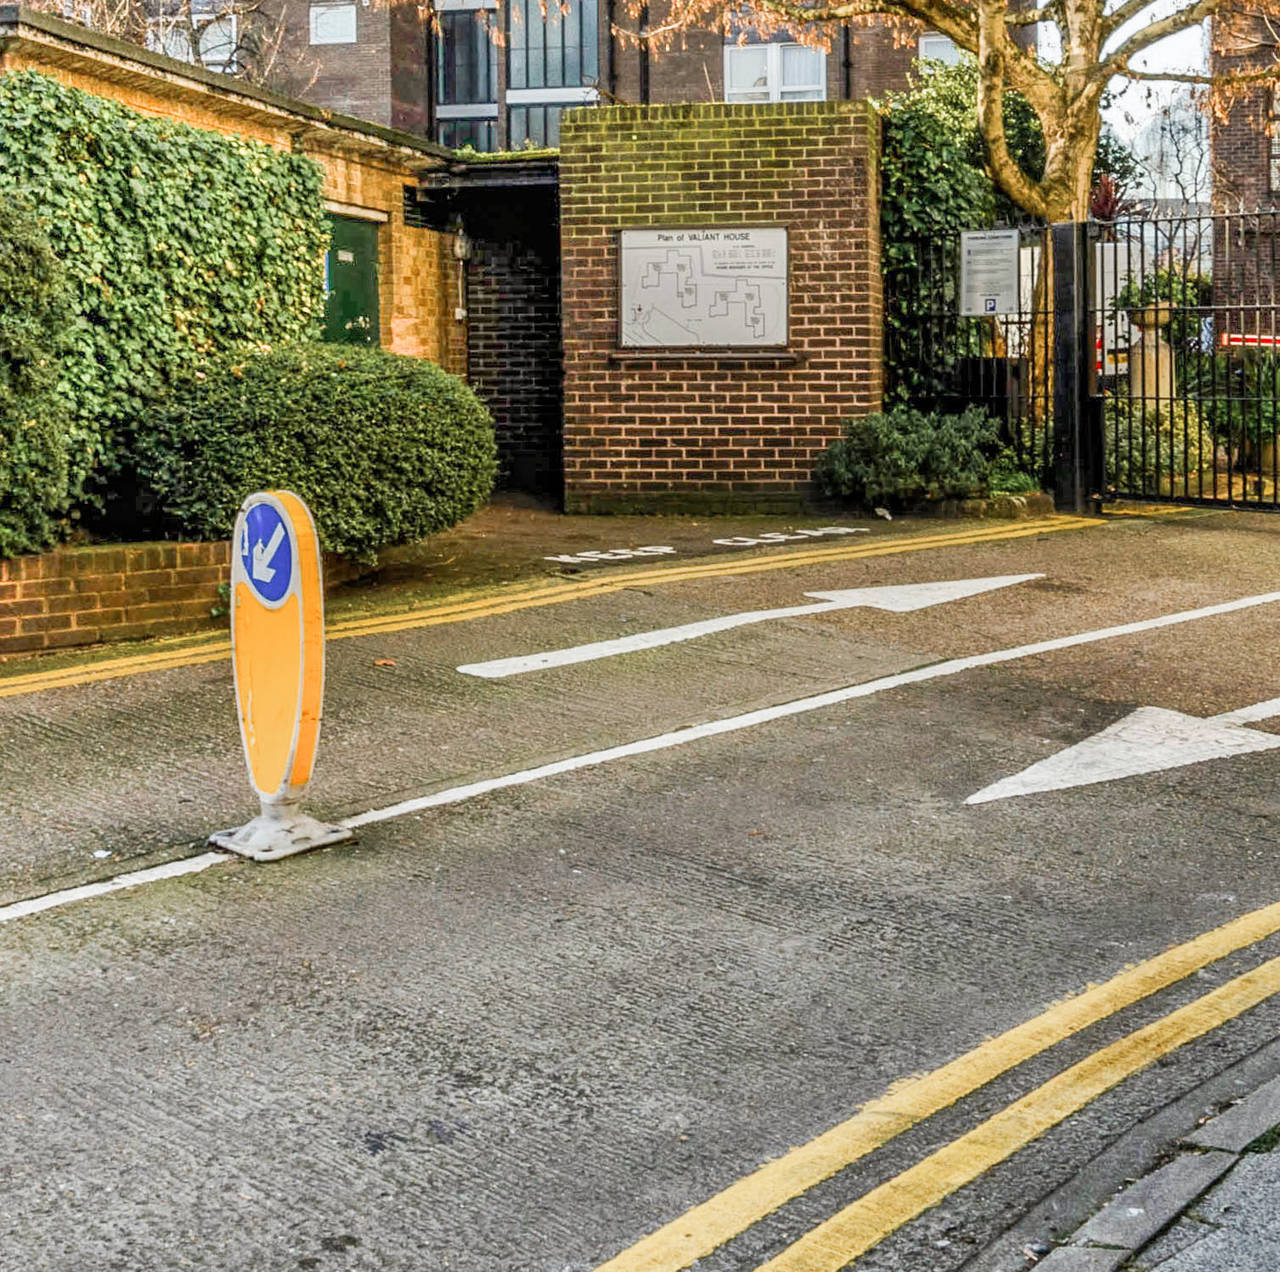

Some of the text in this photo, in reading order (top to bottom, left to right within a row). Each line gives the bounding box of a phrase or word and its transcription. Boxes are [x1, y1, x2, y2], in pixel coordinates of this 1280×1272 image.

[657, 232, 751, 242] Plan of VALIANT HOUSE
[986, 300, 994, 312] P
